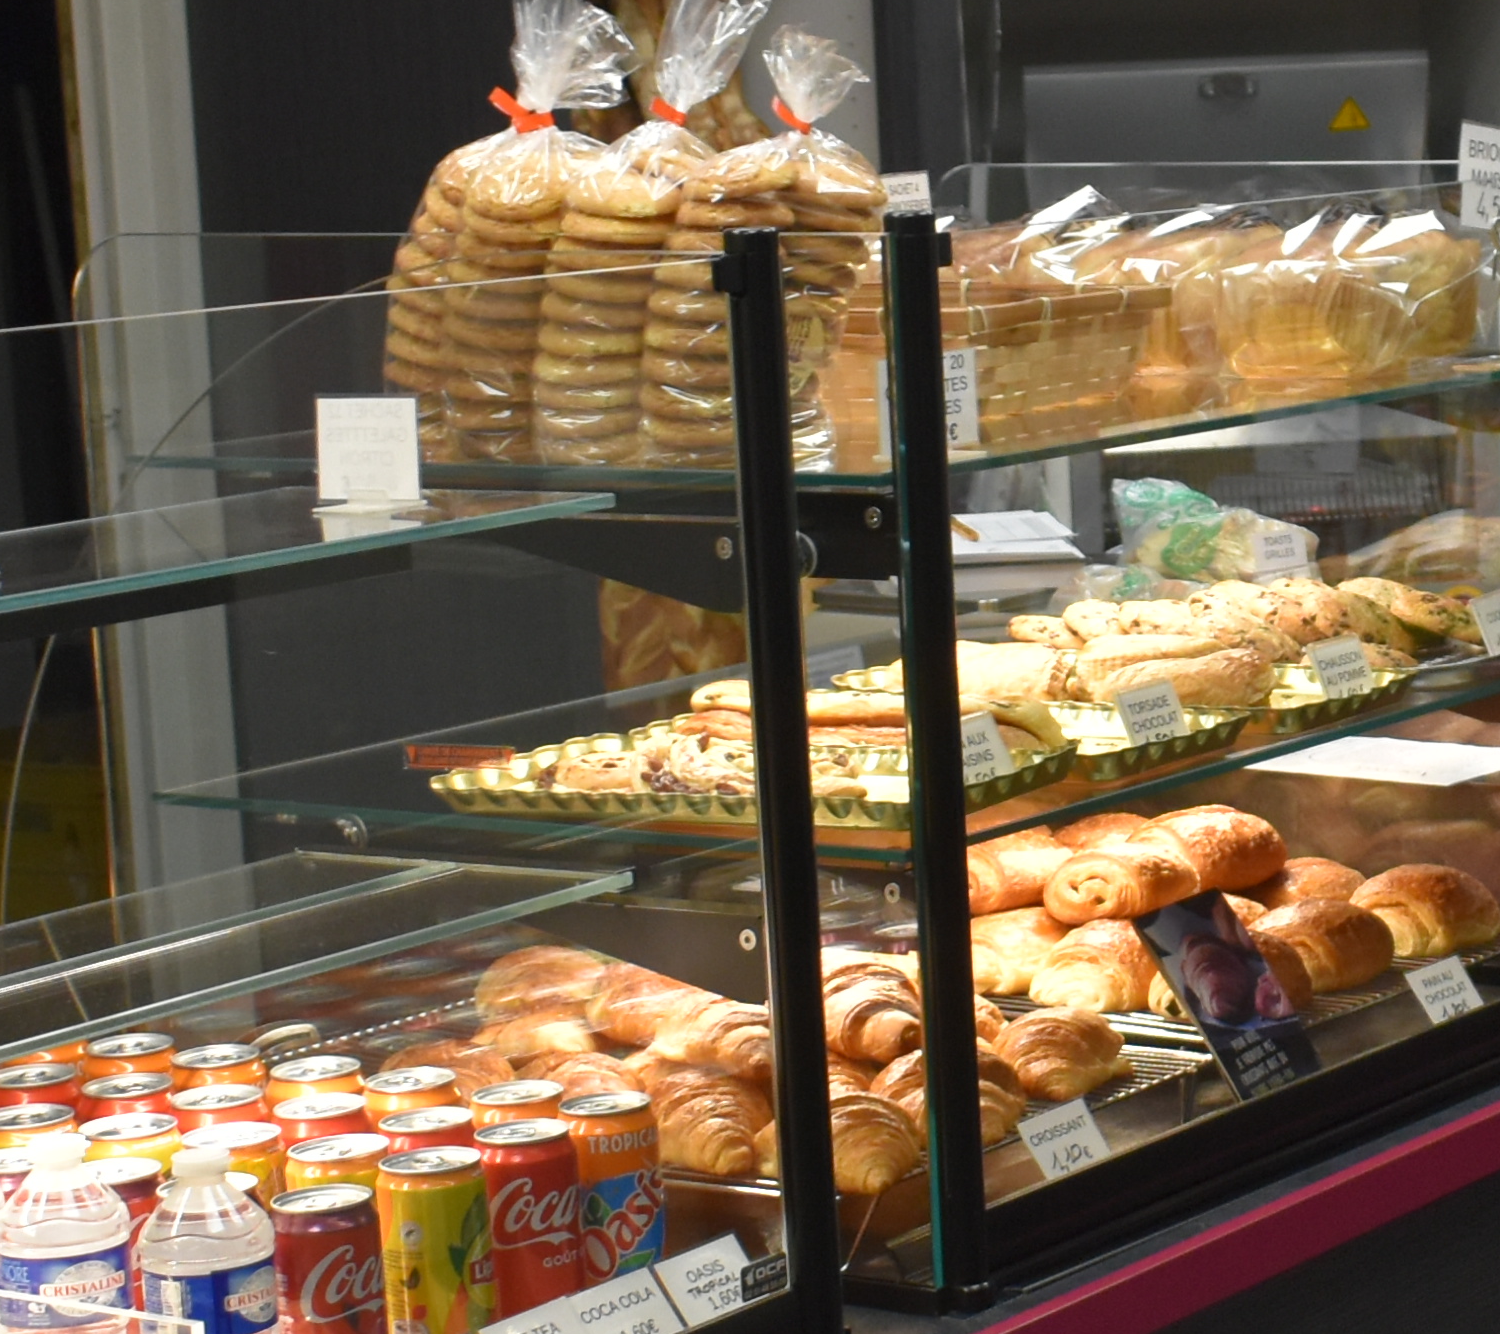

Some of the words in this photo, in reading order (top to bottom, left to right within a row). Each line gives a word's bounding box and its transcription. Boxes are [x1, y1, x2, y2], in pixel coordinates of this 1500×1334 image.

[1319, 650, 1363, 672] CHAUSSON
[1338, 667, 1368, 683] POMME
[1128, 694, 1171, 714] TORSADE
[1132, 711, 1179, 734] CHOCOLAT
[967, 731, 989, 746] AUX
[1425, 982, 1466, 1005] CHOCOLAT
[1030, 1115, 1087, 1147] CROISSANT
[542, 1250, 577, 1267] GOÛT
[685, 1259, 725, 1284] OASIS
[43, 1271, 125, 1298] CRISTALINE
[686, 1273, 740, 1300] TROPICAL
[579, 1302, 619, 1324] COCA
[619, 1286, 656, 1309] COLA
